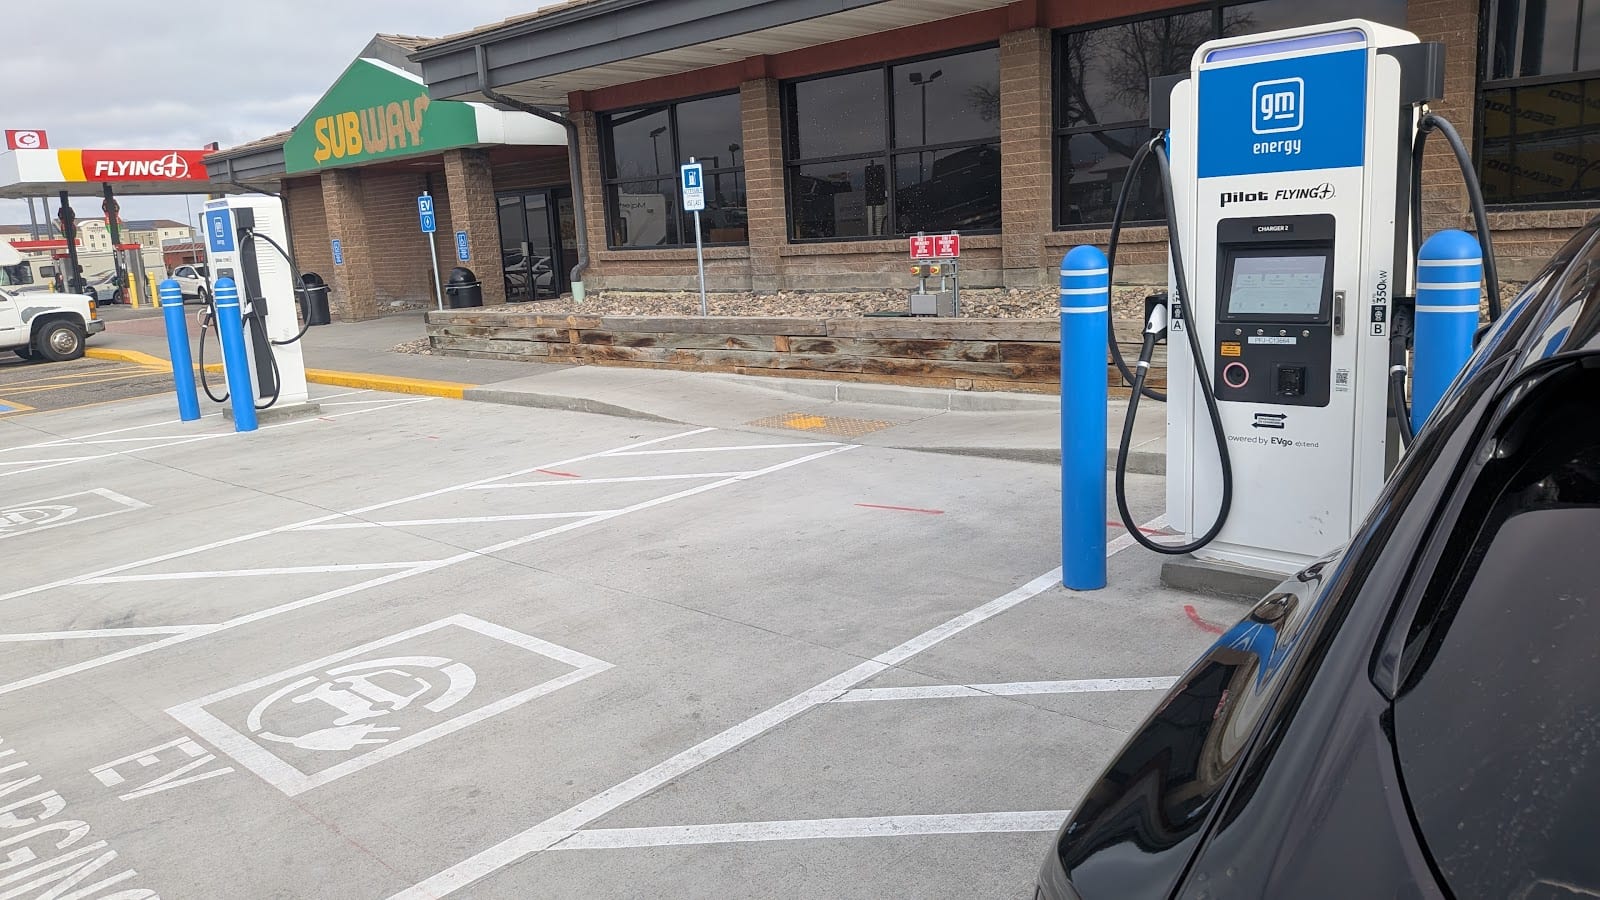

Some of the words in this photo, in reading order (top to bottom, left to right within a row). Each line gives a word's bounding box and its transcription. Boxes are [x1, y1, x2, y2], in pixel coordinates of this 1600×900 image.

[1261, 91, 1294, 120] gm
[313, 92, 430, 164] SUBWAY
[1253, 139, 1301, 155] energy
[420, 200, 430, 211] EV
[1220, 191, 1268, 207] pilot
[1173, 320, 1182, 329] A
[1374, 324, 1382, 334] B
[1227, 435, 1257, 443] owered
[1258, 437, 1268, 446] by
[1270, 437, 1293, 447] EVgo
[89, 736, 235, 801] EV
